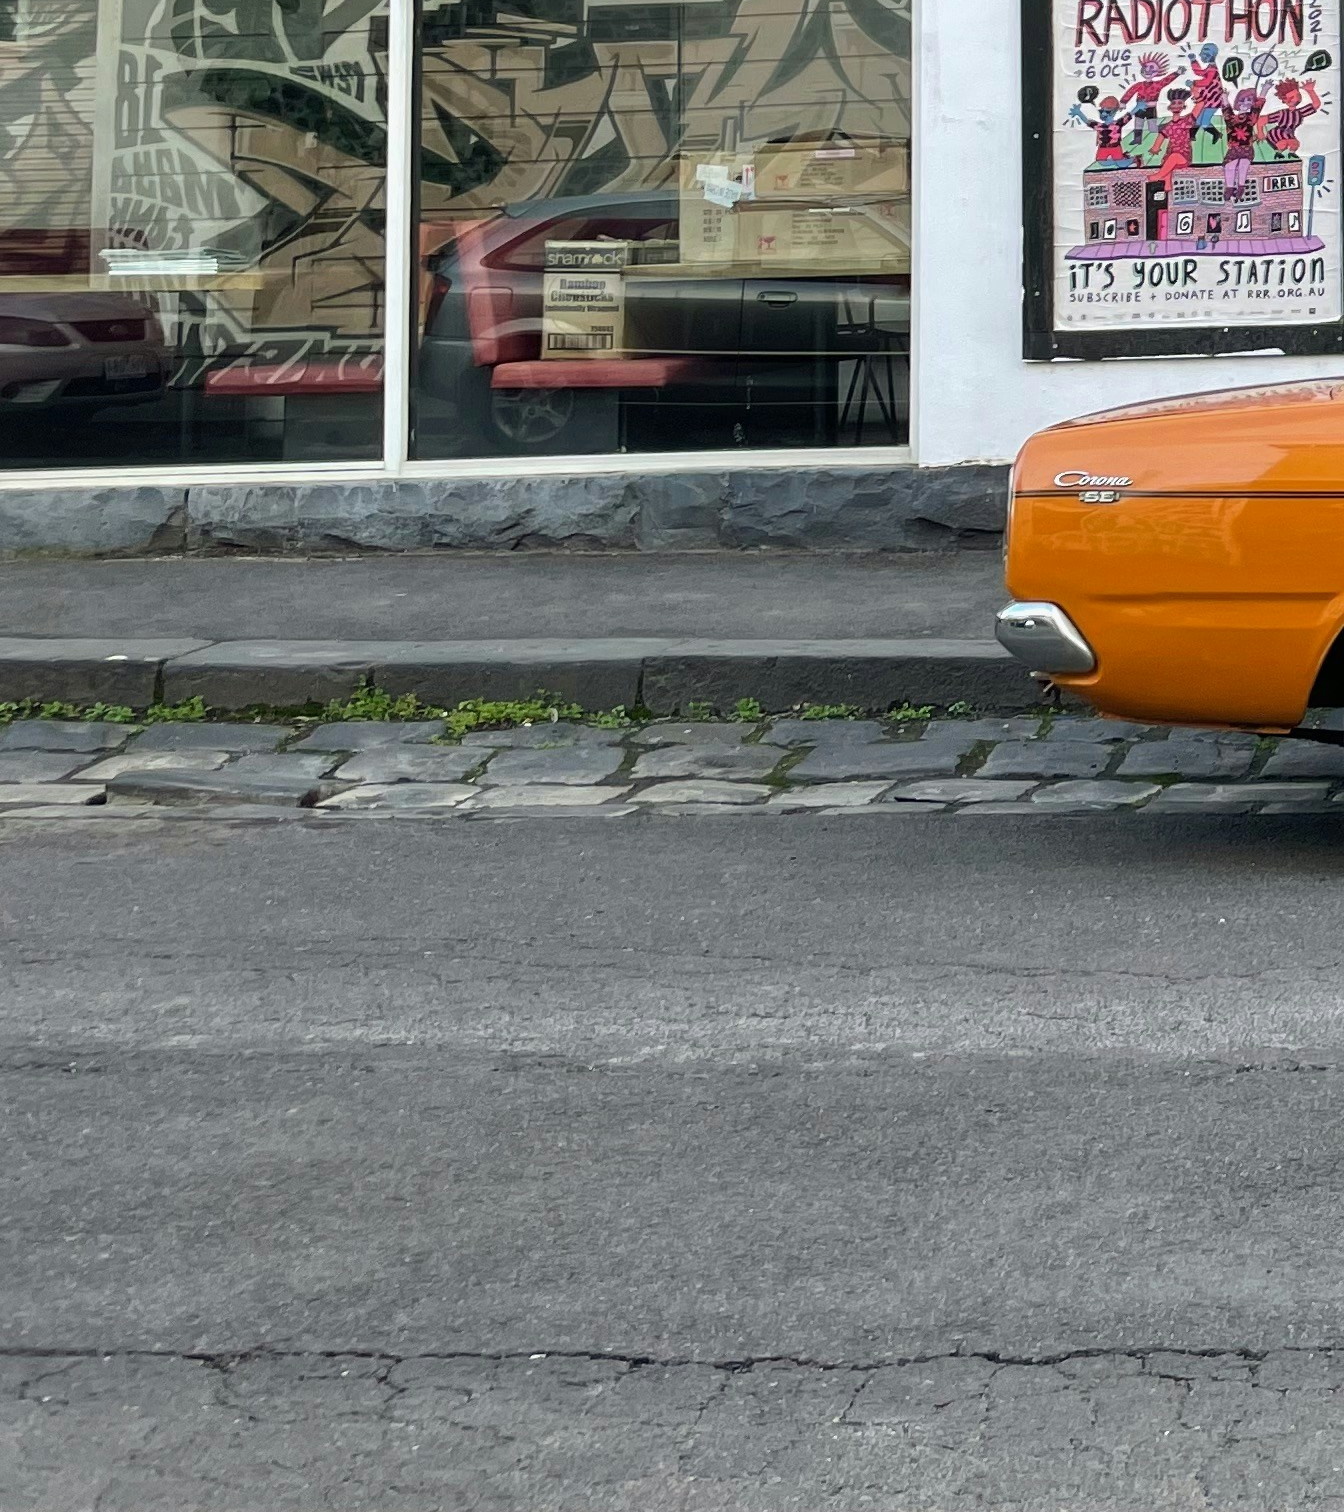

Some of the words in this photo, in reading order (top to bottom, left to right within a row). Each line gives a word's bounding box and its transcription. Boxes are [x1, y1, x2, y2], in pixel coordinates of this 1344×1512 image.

[1074, 50, 1096, 64] 27
[1101, 49, 1132, 62] AUG
[1100, 65, 1132, 77] OCT
[1069, 291, 1142, 303] SUBSCRIBE
[1165, 290, 1214, 301] DONATE
[1222, 289, 1239, 299] AT
[1247, 287, 1326, 300] RRR.ORG.AU
[1053, 470, 1134, 487] Corona
[1083, 490, 1115, 503] SE
